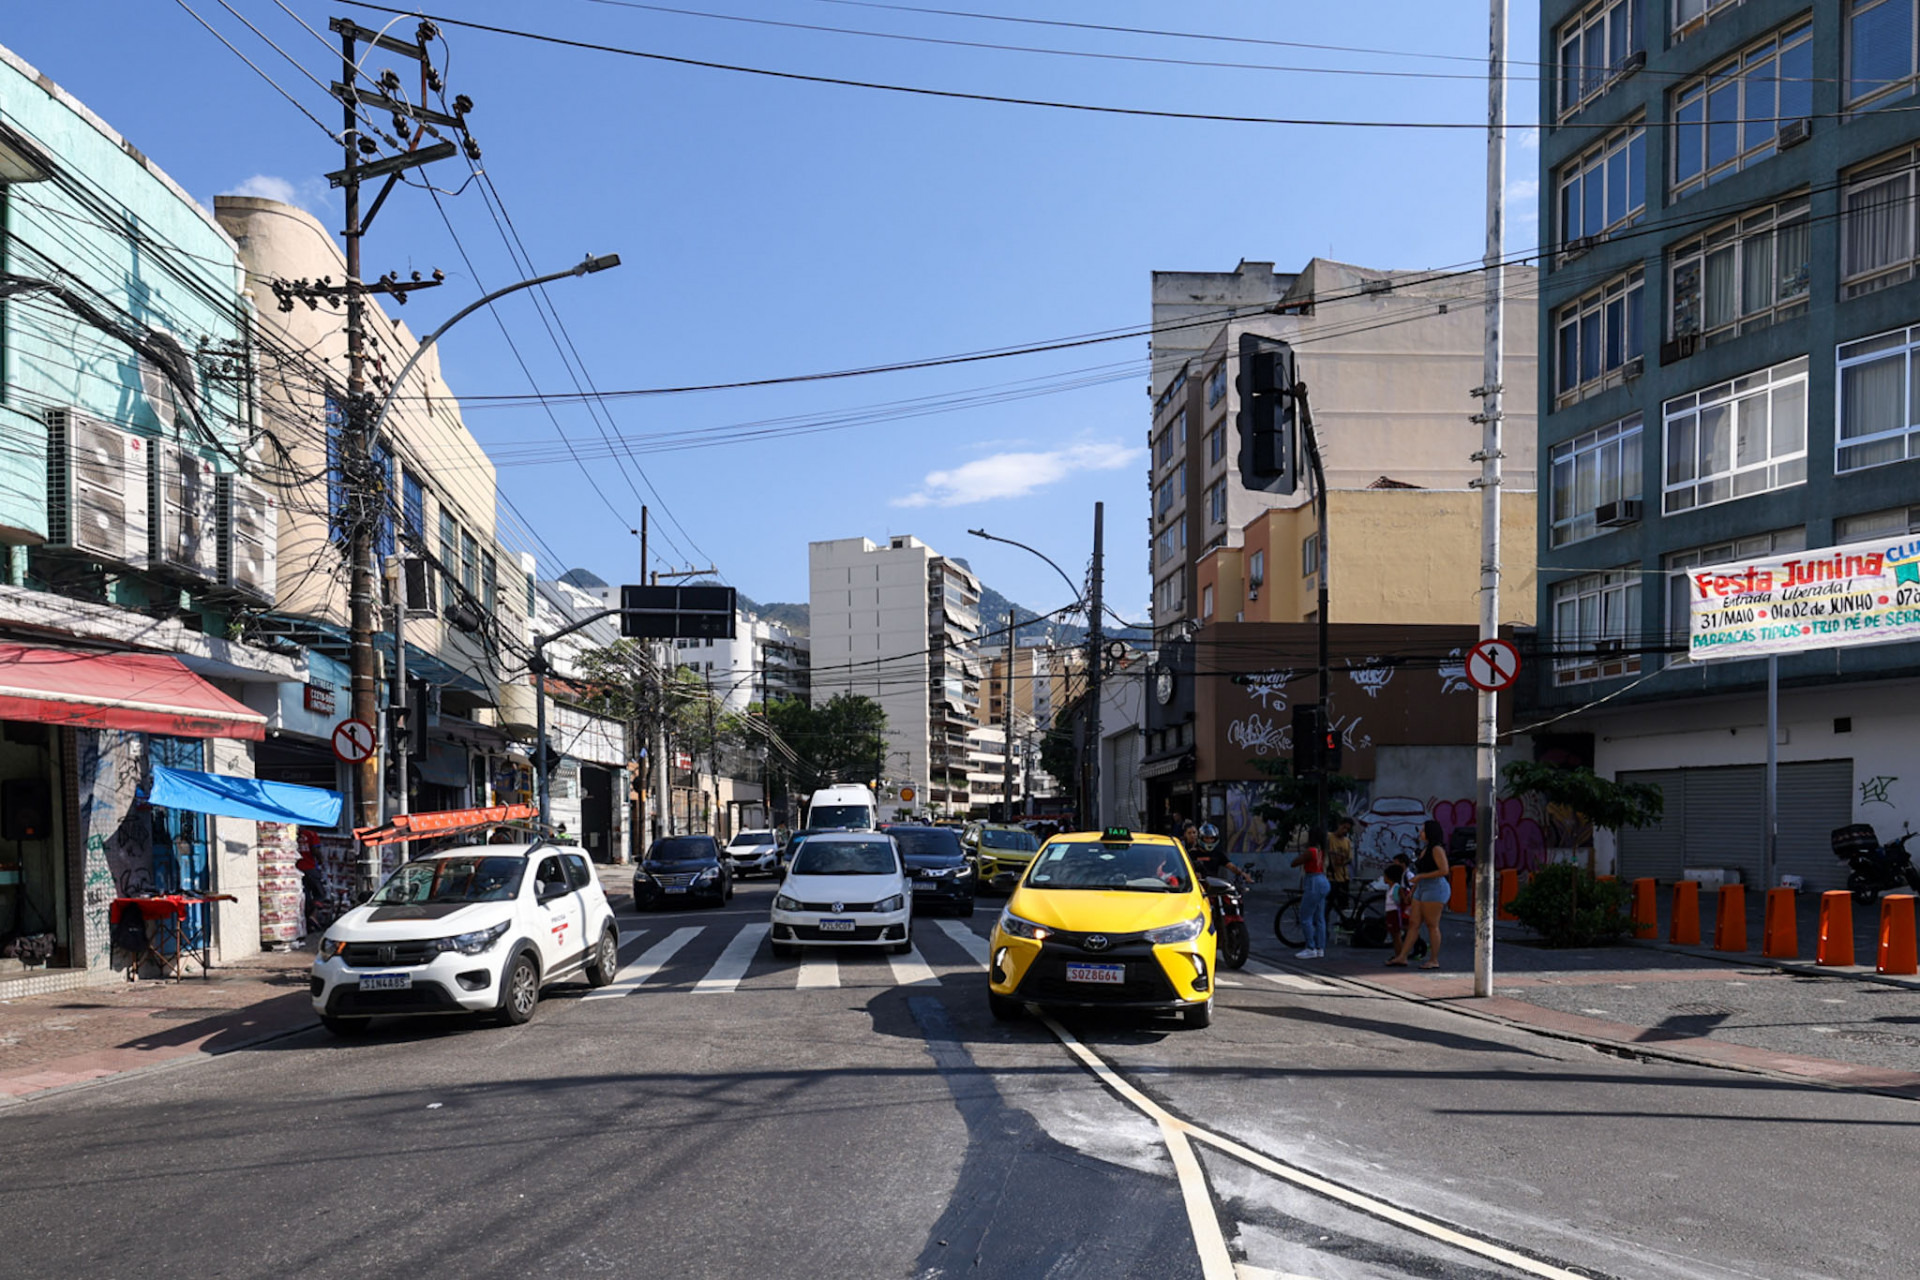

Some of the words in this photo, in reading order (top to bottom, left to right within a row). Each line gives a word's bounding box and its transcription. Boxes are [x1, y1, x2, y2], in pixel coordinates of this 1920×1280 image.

[1694, 565, 1772, 598] Festa
[1781, 552, 1884, 588] Junina
[1701, 608, 1754, 629] 31/MAIO
[1810, 601, 1825, 616] de
[1829, 593, 1873, 616] JUNHO
[1723, 592, 1772, 608] Entrada
[1693, 628, 1756, 648] BARRACAS
[1760, 622, 1801, 641] TÍPICAS
[1812, 619, 1839, 635] TRIO
[1844, 612, 1861, 631] PÉ
[1864, 614, 1881, 628] DE
[1108, 827, 1128, 836] TAXI
